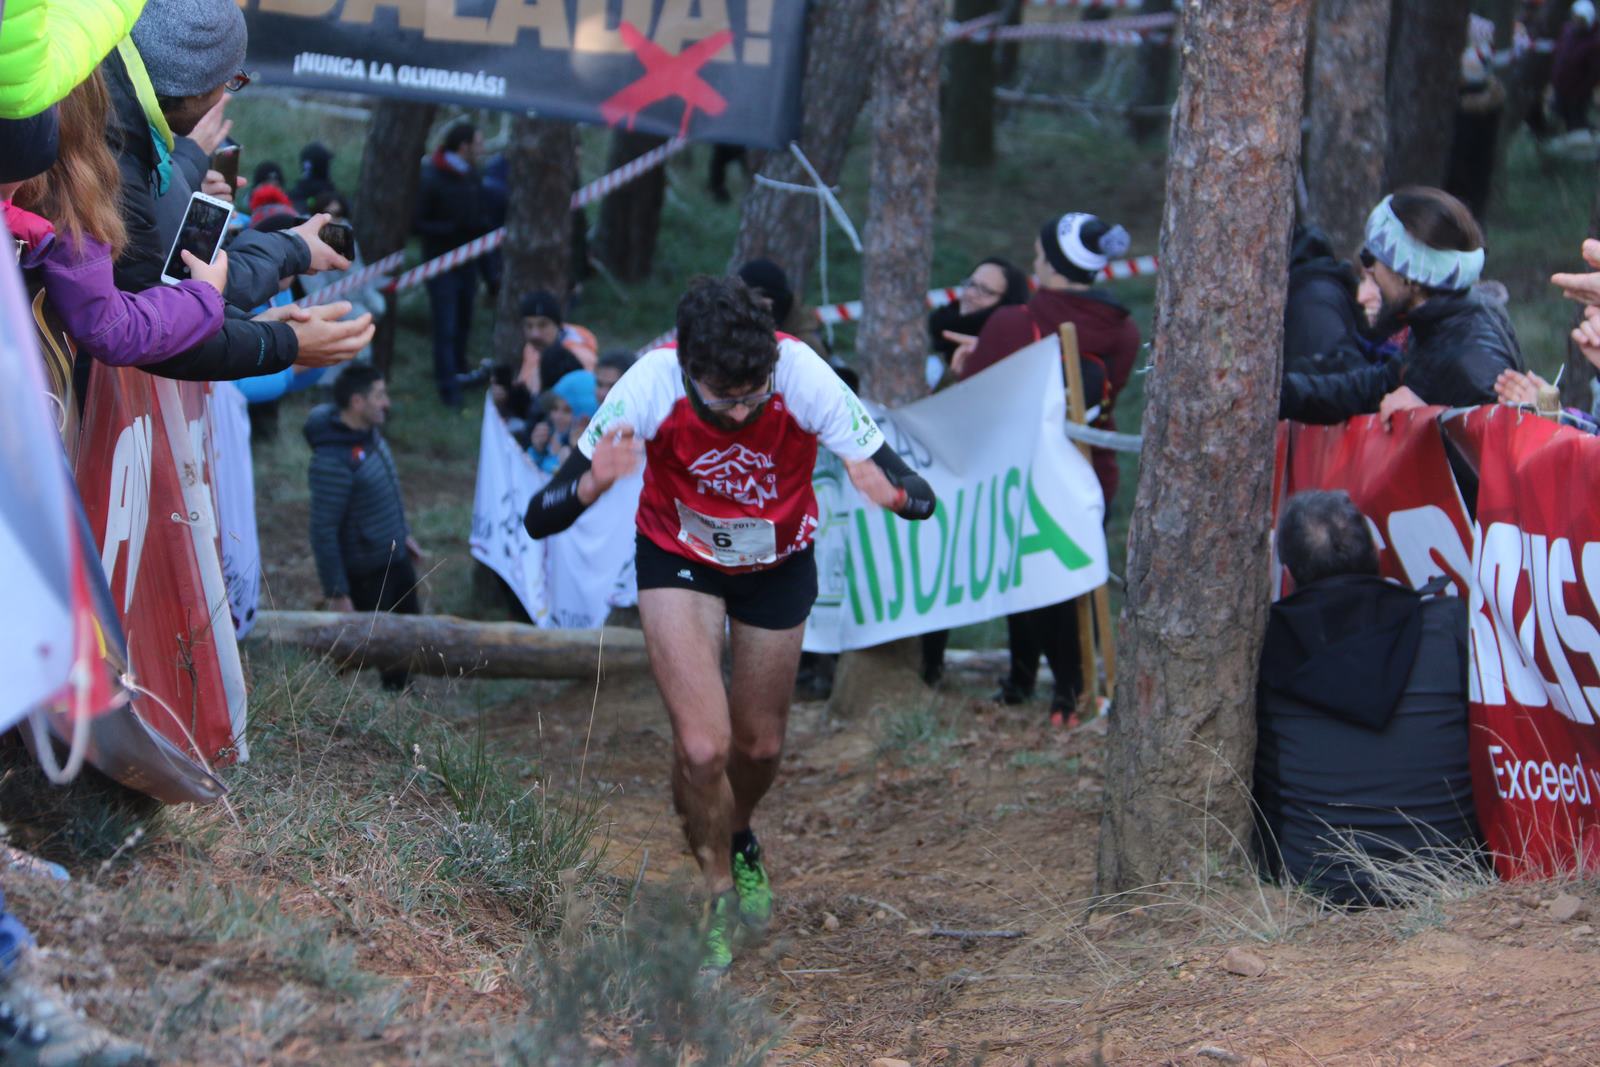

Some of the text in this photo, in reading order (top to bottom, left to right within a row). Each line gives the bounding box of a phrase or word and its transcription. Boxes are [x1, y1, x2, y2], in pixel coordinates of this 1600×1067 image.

[293, 52, 506, 97] ¡NUNCA LA OLVIDARÁS!
[713, 532, 733, 548] 6
[1488, 745, 1591, 805] Exceed
